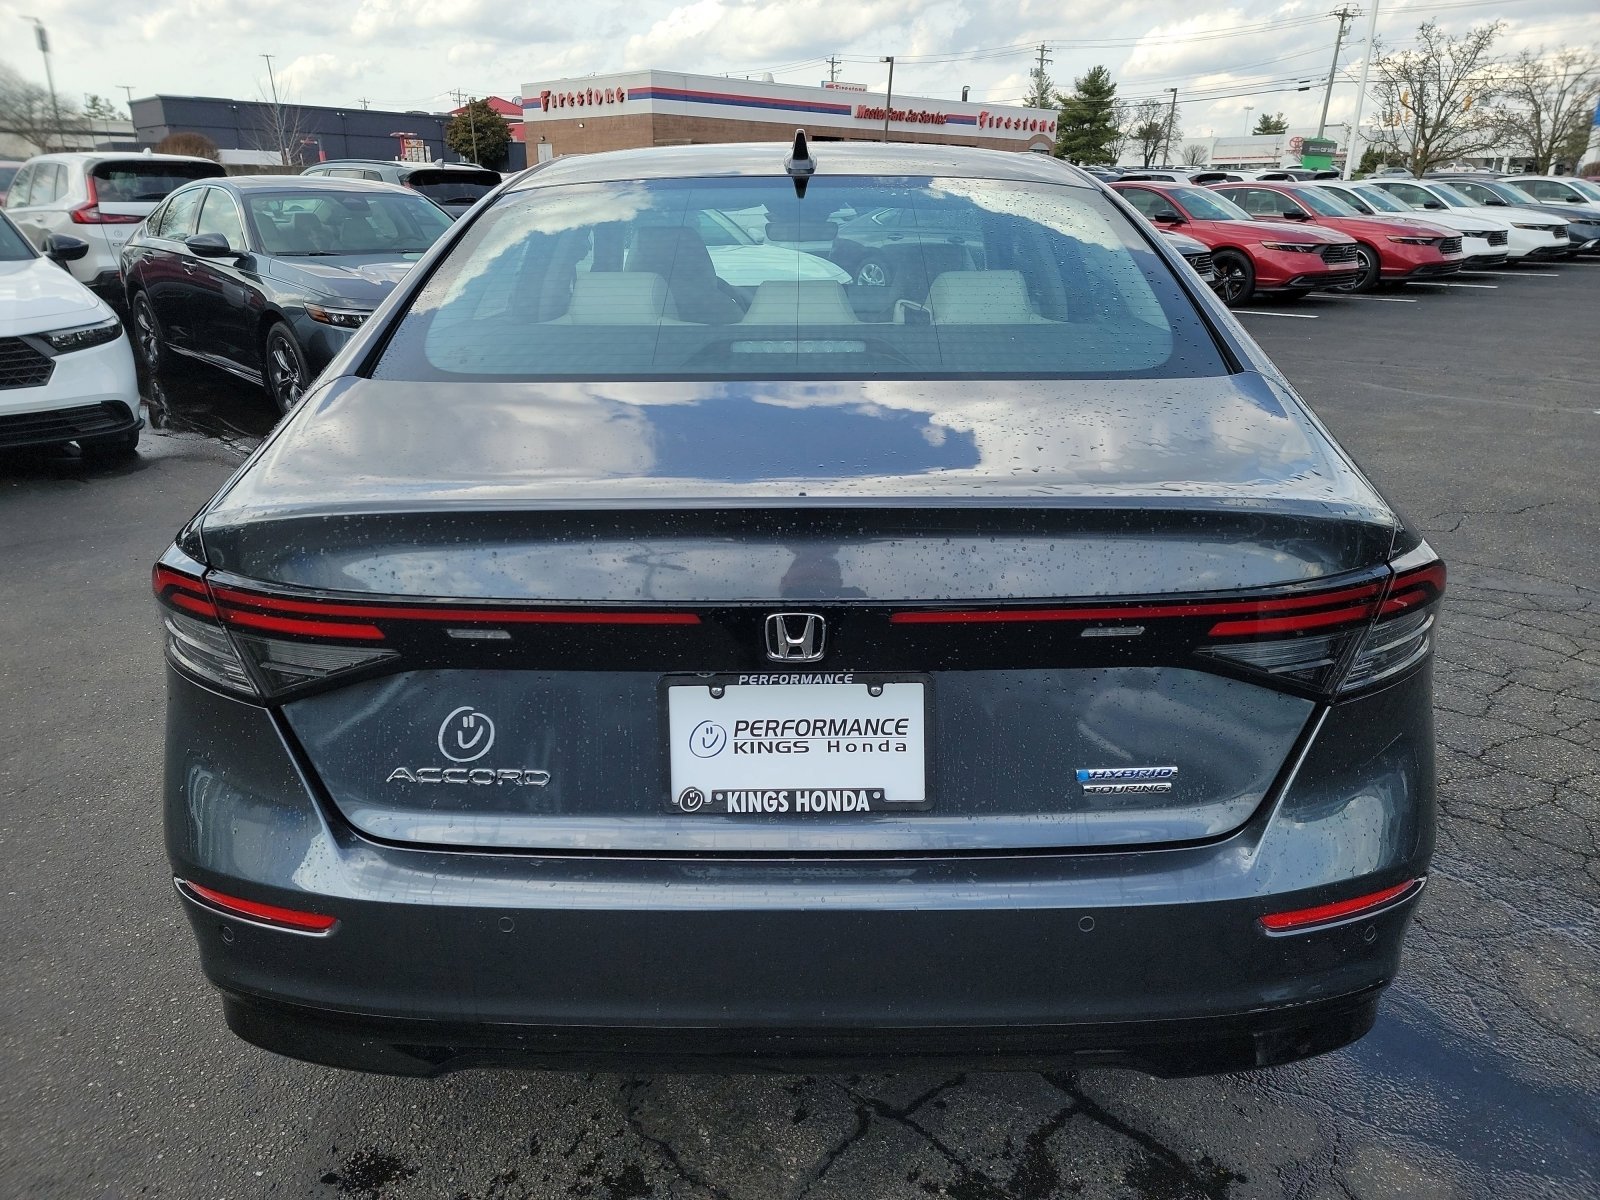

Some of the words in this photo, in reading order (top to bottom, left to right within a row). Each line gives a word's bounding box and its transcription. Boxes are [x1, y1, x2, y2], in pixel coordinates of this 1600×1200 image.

[541, 87, 624, 112] Firestone
[979, 111, 1055, 132] Firestone
[738, 673, 854, 685] PERFORMANCE
[733, 718, 909, 737] PERFORMANCE
[733, 740, 810, 754] KINGS
[827, 739, 907, 753] Honda
[386, 767, 551, 786] ACCORD
[1089, 766, 1174, 780] HYBRID
[1088, 784, 1169, 794] TOURING
[727, 791, 790, 813] KINGS
[795, 790, 870, 812] HONDA
